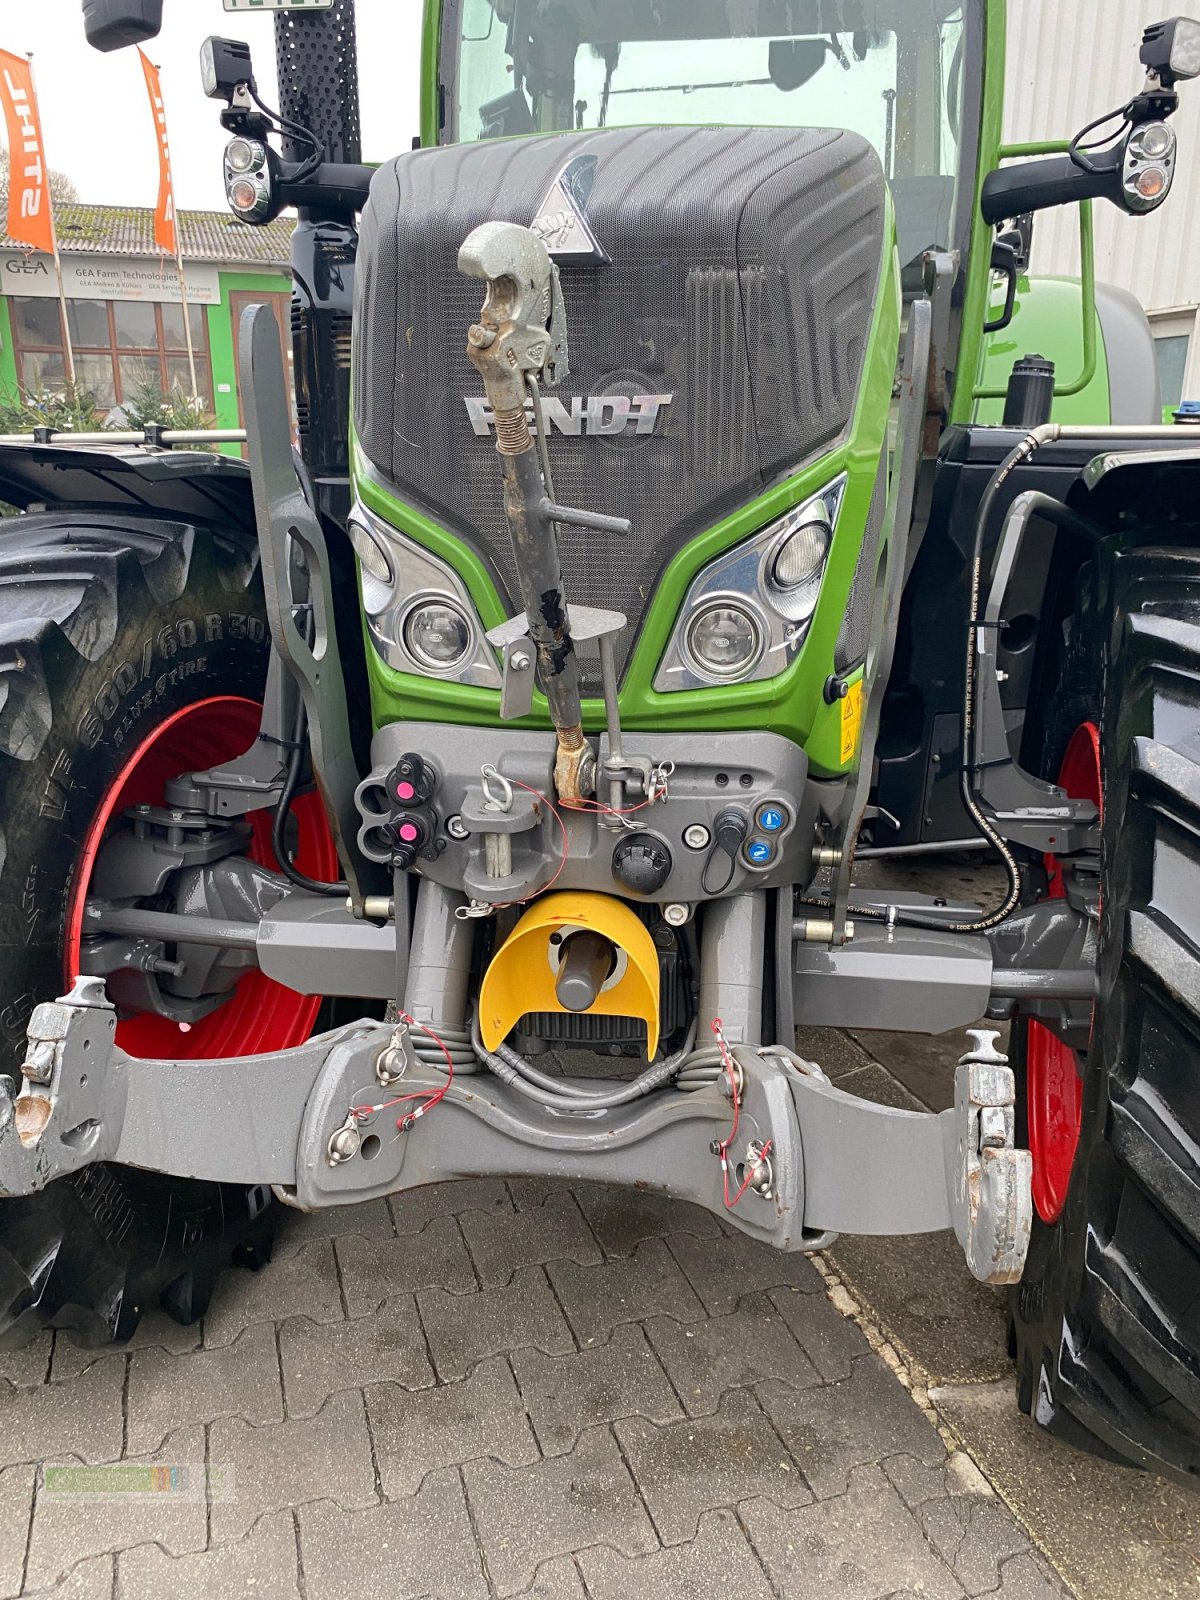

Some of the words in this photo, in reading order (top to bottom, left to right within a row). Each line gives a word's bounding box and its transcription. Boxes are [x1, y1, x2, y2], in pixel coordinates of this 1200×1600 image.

[5, 259, 49, 276] GEA
[75, 268, 94, 278] GEA
[96, 269, 119, 279] Farm
[122, 270, 178, 283] Technologies
[79, 280, 92, 288] GEA
